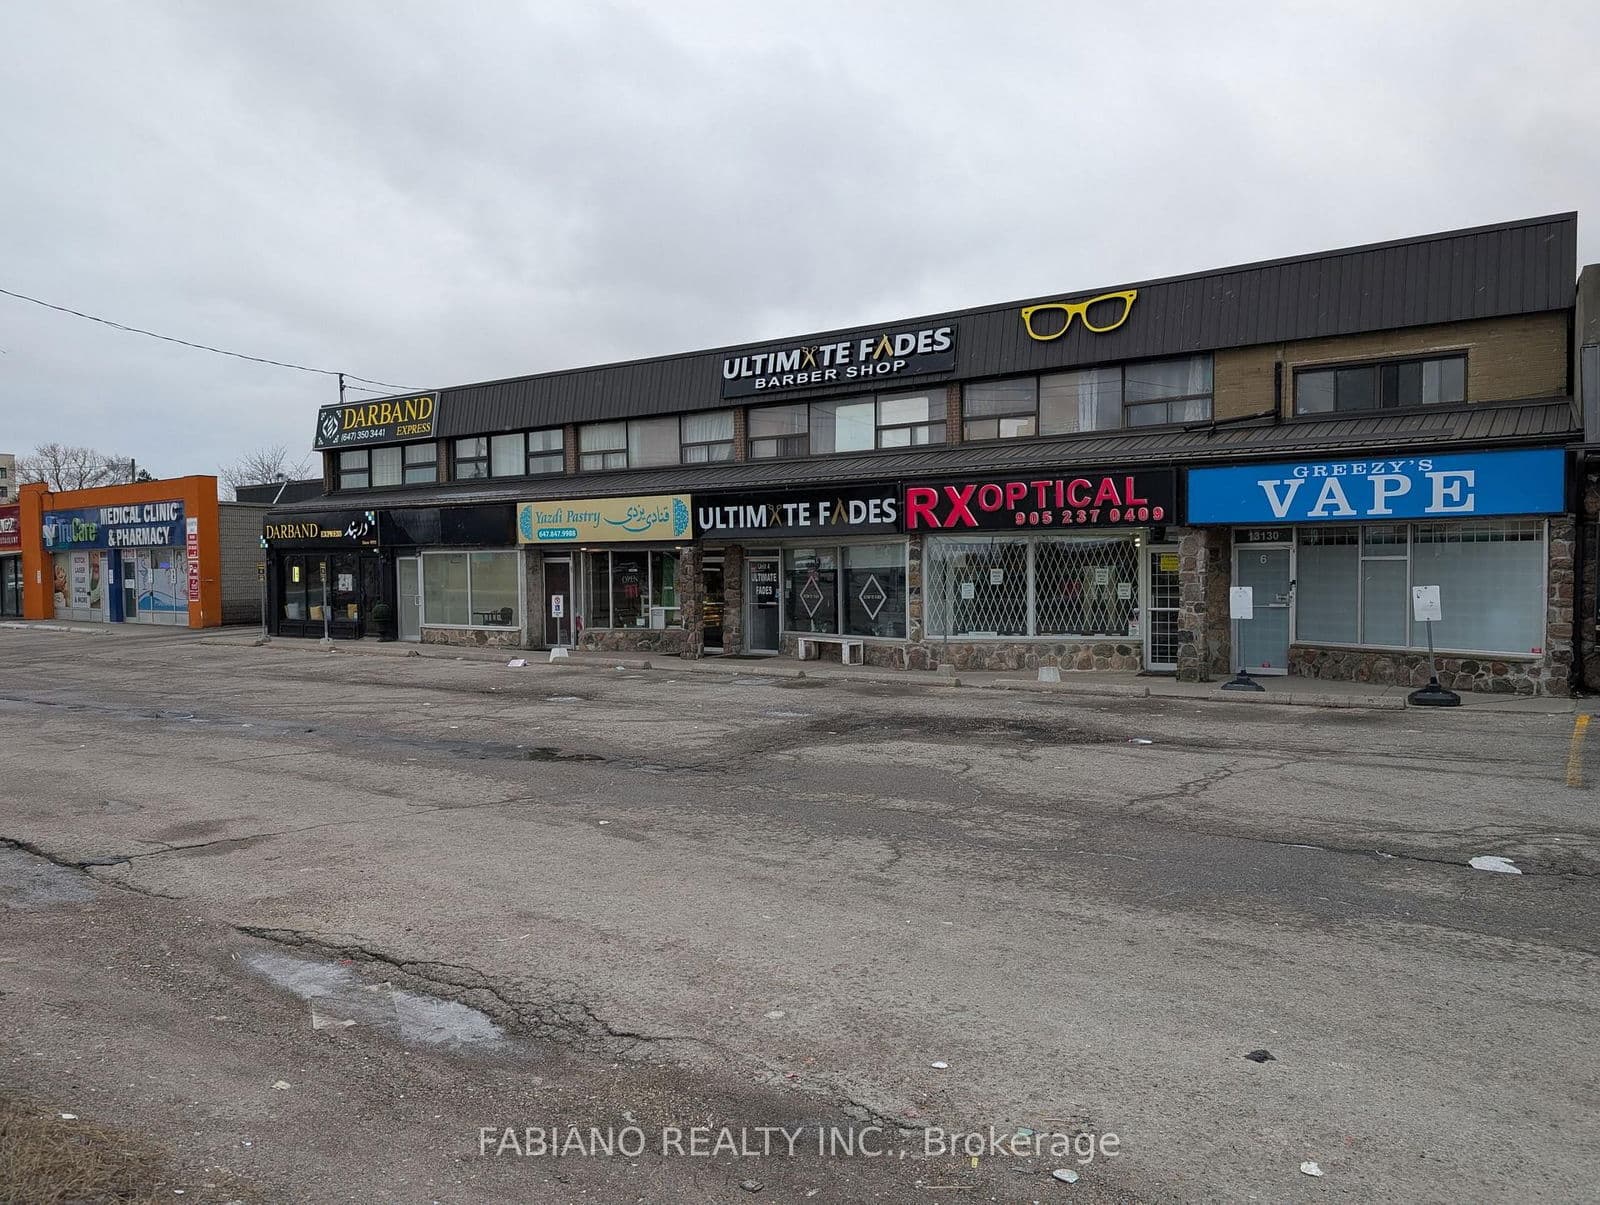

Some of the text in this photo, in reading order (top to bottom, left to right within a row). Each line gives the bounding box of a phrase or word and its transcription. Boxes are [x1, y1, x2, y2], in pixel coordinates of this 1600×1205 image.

[755, 359, 906, 389] BARBER SHOP
[342, 397, 433, 430] DARBAND
[341, 428, 386, 442] (647) 350 3441
[396, 422, 431, 436] EXPRESS
[1293, 459, 1433, 479] GREEZY'S
[906, 476, 1148, 529] RX OPTICAL
[1257, 469, 1475, 518] VAPE
[100, 502, 179, 525] MEDICAL CLINIC
[536, 507, 600, 529] Yazdi Pastry
[1015, 506, 1164, 525] 905 237 0409
[108, 529, 117, 547] &
[116, 526, 170, 546] PHARMACY
[266, 523, 318, 539] DARBAND
[1260, 554, 1267, 564] 6
[751, 572, 777, 582] ULTIMATE
[756, 585, 773, 595] FADES
